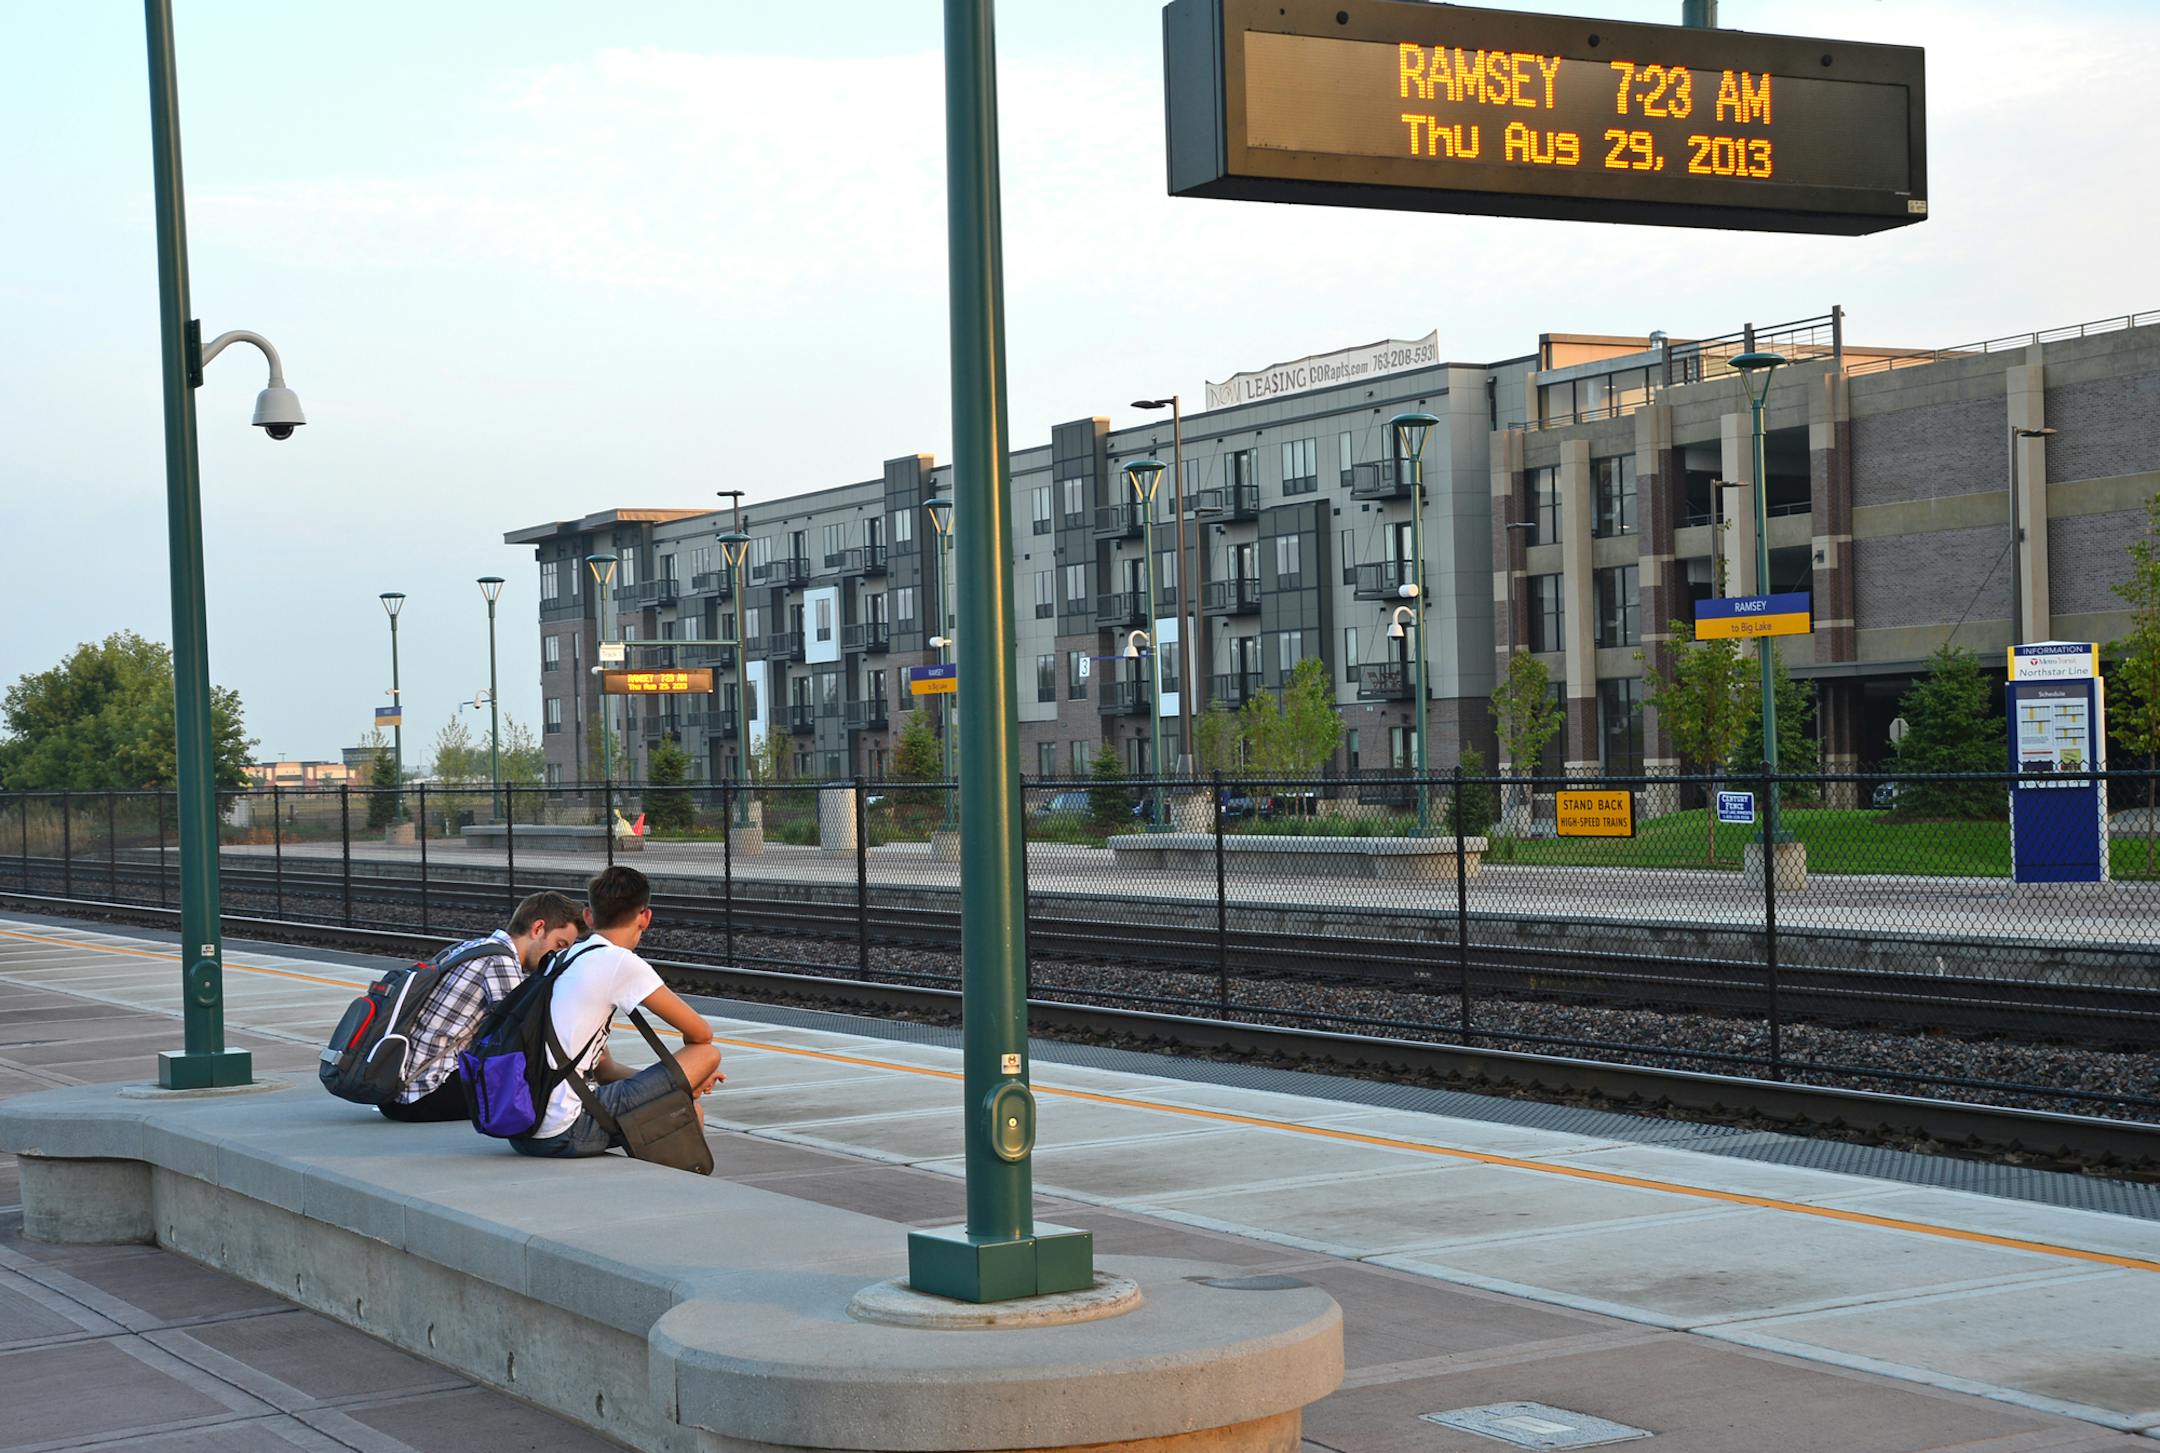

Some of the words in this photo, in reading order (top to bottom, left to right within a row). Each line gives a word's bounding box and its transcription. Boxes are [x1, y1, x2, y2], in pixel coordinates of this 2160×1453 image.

[1400, 43, 1561, 109] RAMSEY
[1610, 61, 1692, 118] 7:23
[1716, 70, 1772, 125] AM
[1401, 114, 1480, 158] Thu
[1505, 121, 1580, 165] Aug
[1604, 129, 1664, 171] 29,
[1687, 135, 1772, 178] 2013
[1246, 367, 1307, 399] LEASING
[1372, 343, 1436, 372] 763-208-5931
[1734, 600, 1767, 613] RAMSEY
[1731, 624, 1739, 632] to
[1741, 623, 1753, 633] Big
[1755, 622, 1772, 631] Lake
[2023, 646, 2083, 655] INFORMATION
[1081, 659, 1088, 675] 3
[2020, 668, 2066, 677] Northstar
[2068, 667, 2089, 675] Line
[1563, 799, 1593, 810] STAND
[1598, 799, 1623, 810] BACK
[1560, 817, 1600, 828] HIGH-SPEED
[1603, 817, 1628, 828] TRAINS
